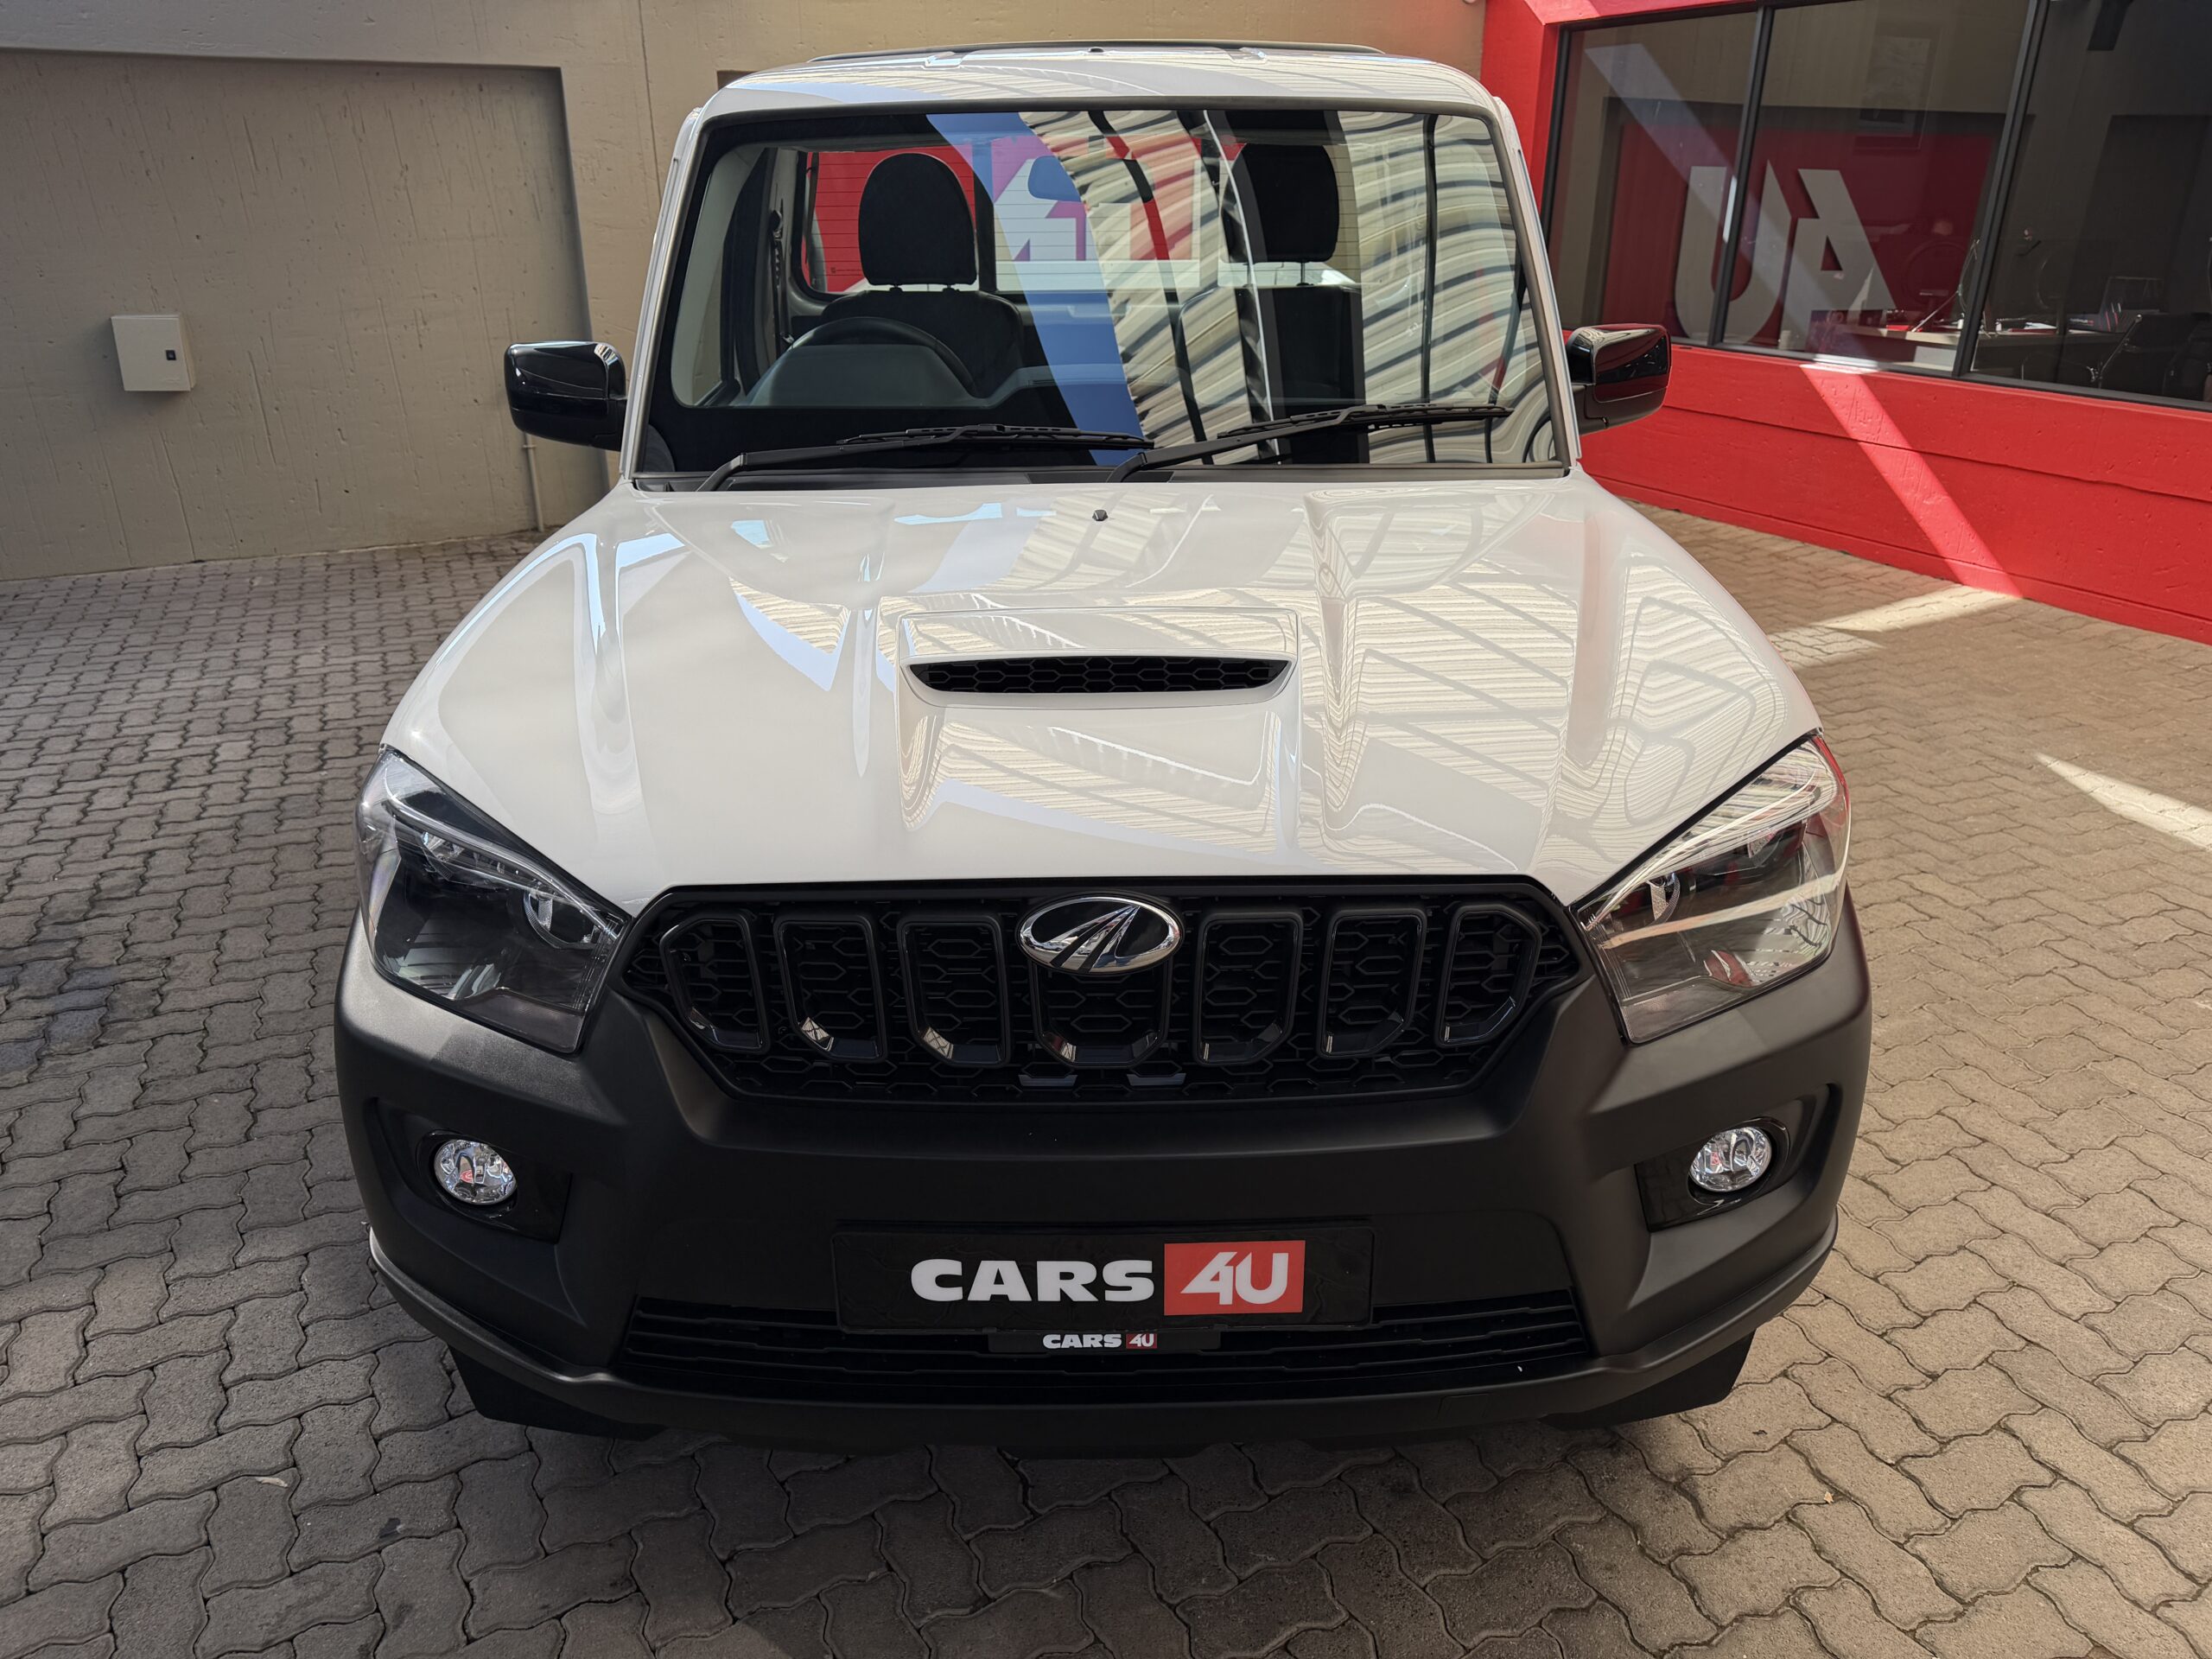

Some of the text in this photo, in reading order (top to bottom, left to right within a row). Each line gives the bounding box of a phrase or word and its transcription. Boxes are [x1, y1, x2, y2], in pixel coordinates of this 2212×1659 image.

[911, 1251, 1289, 1306] CARS 4U
[1042, 1333, 1154, 1349] CARS 4U
